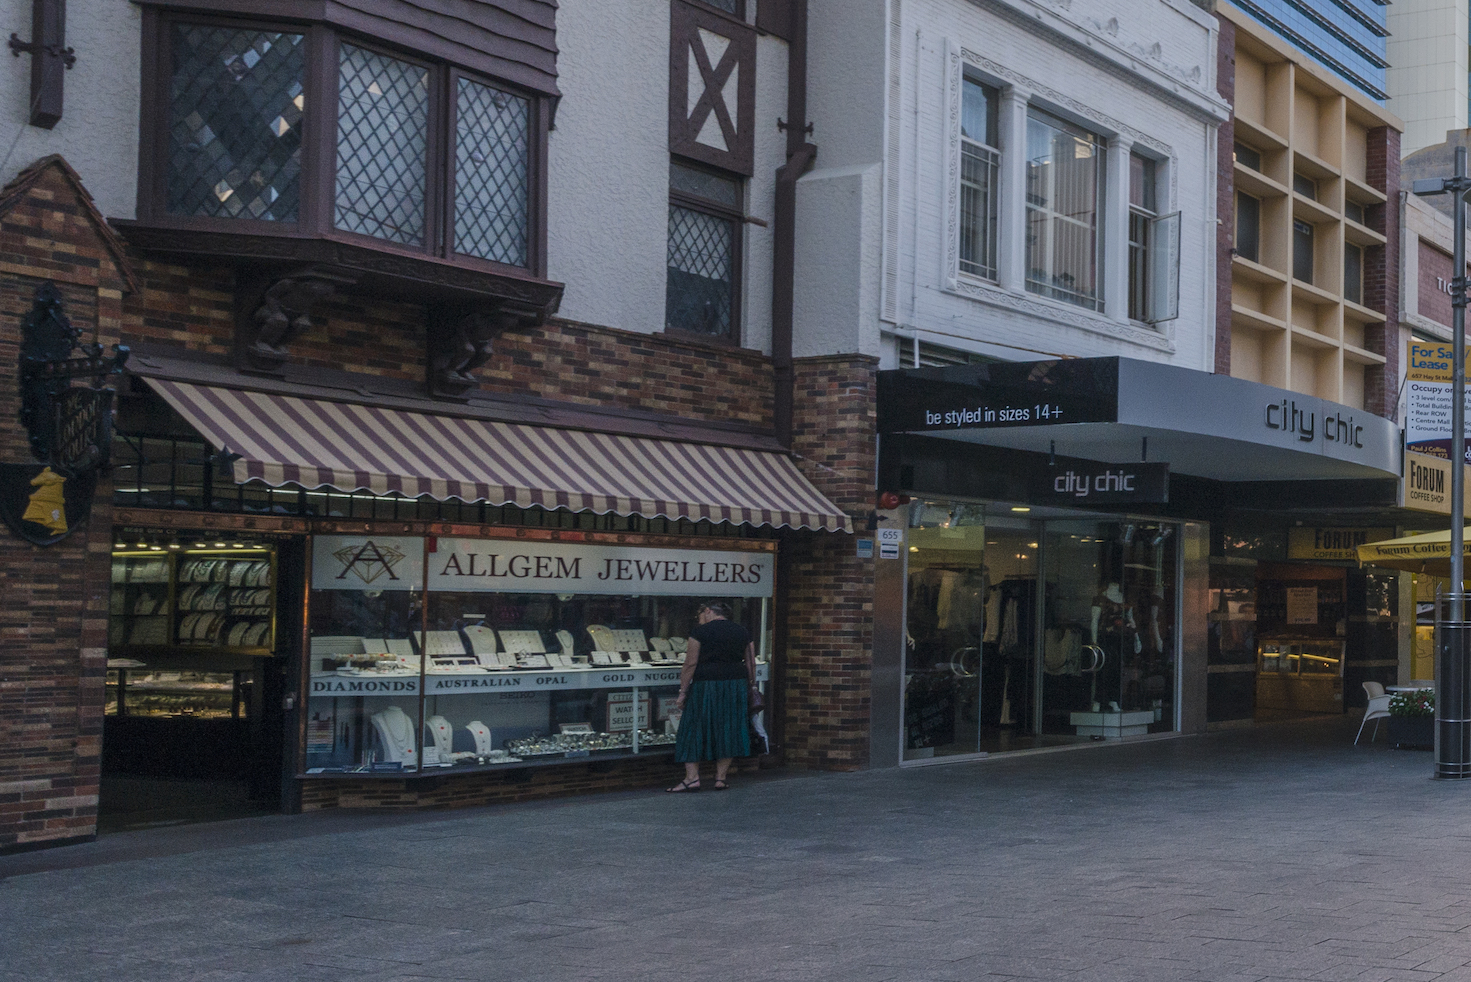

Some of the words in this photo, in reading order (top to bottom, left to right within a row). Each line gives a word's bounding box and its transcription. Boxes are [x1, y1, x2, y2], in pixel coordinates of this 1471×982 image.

[1411, 345, 1434, 358] For
[1411, 357, 1448, 370] Lease
[1411, 384, 1443, 394] Occupy
[926, 410, 942, 425] be
[945, 407, 982, 427] styled
[984, 406, 996, 422] in
[999, 405, 1030, 422] sizes
[1034, 404, 1064, 420] 14+
[1264, 399, 1314, 442] city
[1325, 412, 1363, 449] chic
[1054, 470, 1090, 497] city
[1094, 469, 1135, 492] chic
[1410, 459, 1445, 494] FORUM
[1410, 490, 1430, 502] COFFEE
[1430, 494, 1445, 503] SHOP
[882, 530, 898, 540] 655
[1314, 528, 1367, 551] FORUM
[1313, 550, 1342, 558] COFFEE
[1412, 543, 1447, 553] Coffee
[440, 552, 582, 579] ALLGEM
[597, 558, 762, 584] JEWELLERS
[435, 677, 522, 689] AUSTRALIAN
[536, 675, 568, 685] OPAL
[602, 674, 635, 683] GOLD
[644, 672, 681, 682] NUGGE
[313, 681, 417, 692] DIAMONDS
[612, 693, 643, 701] CITIZN
[615, 705, 643, 714] WATH
